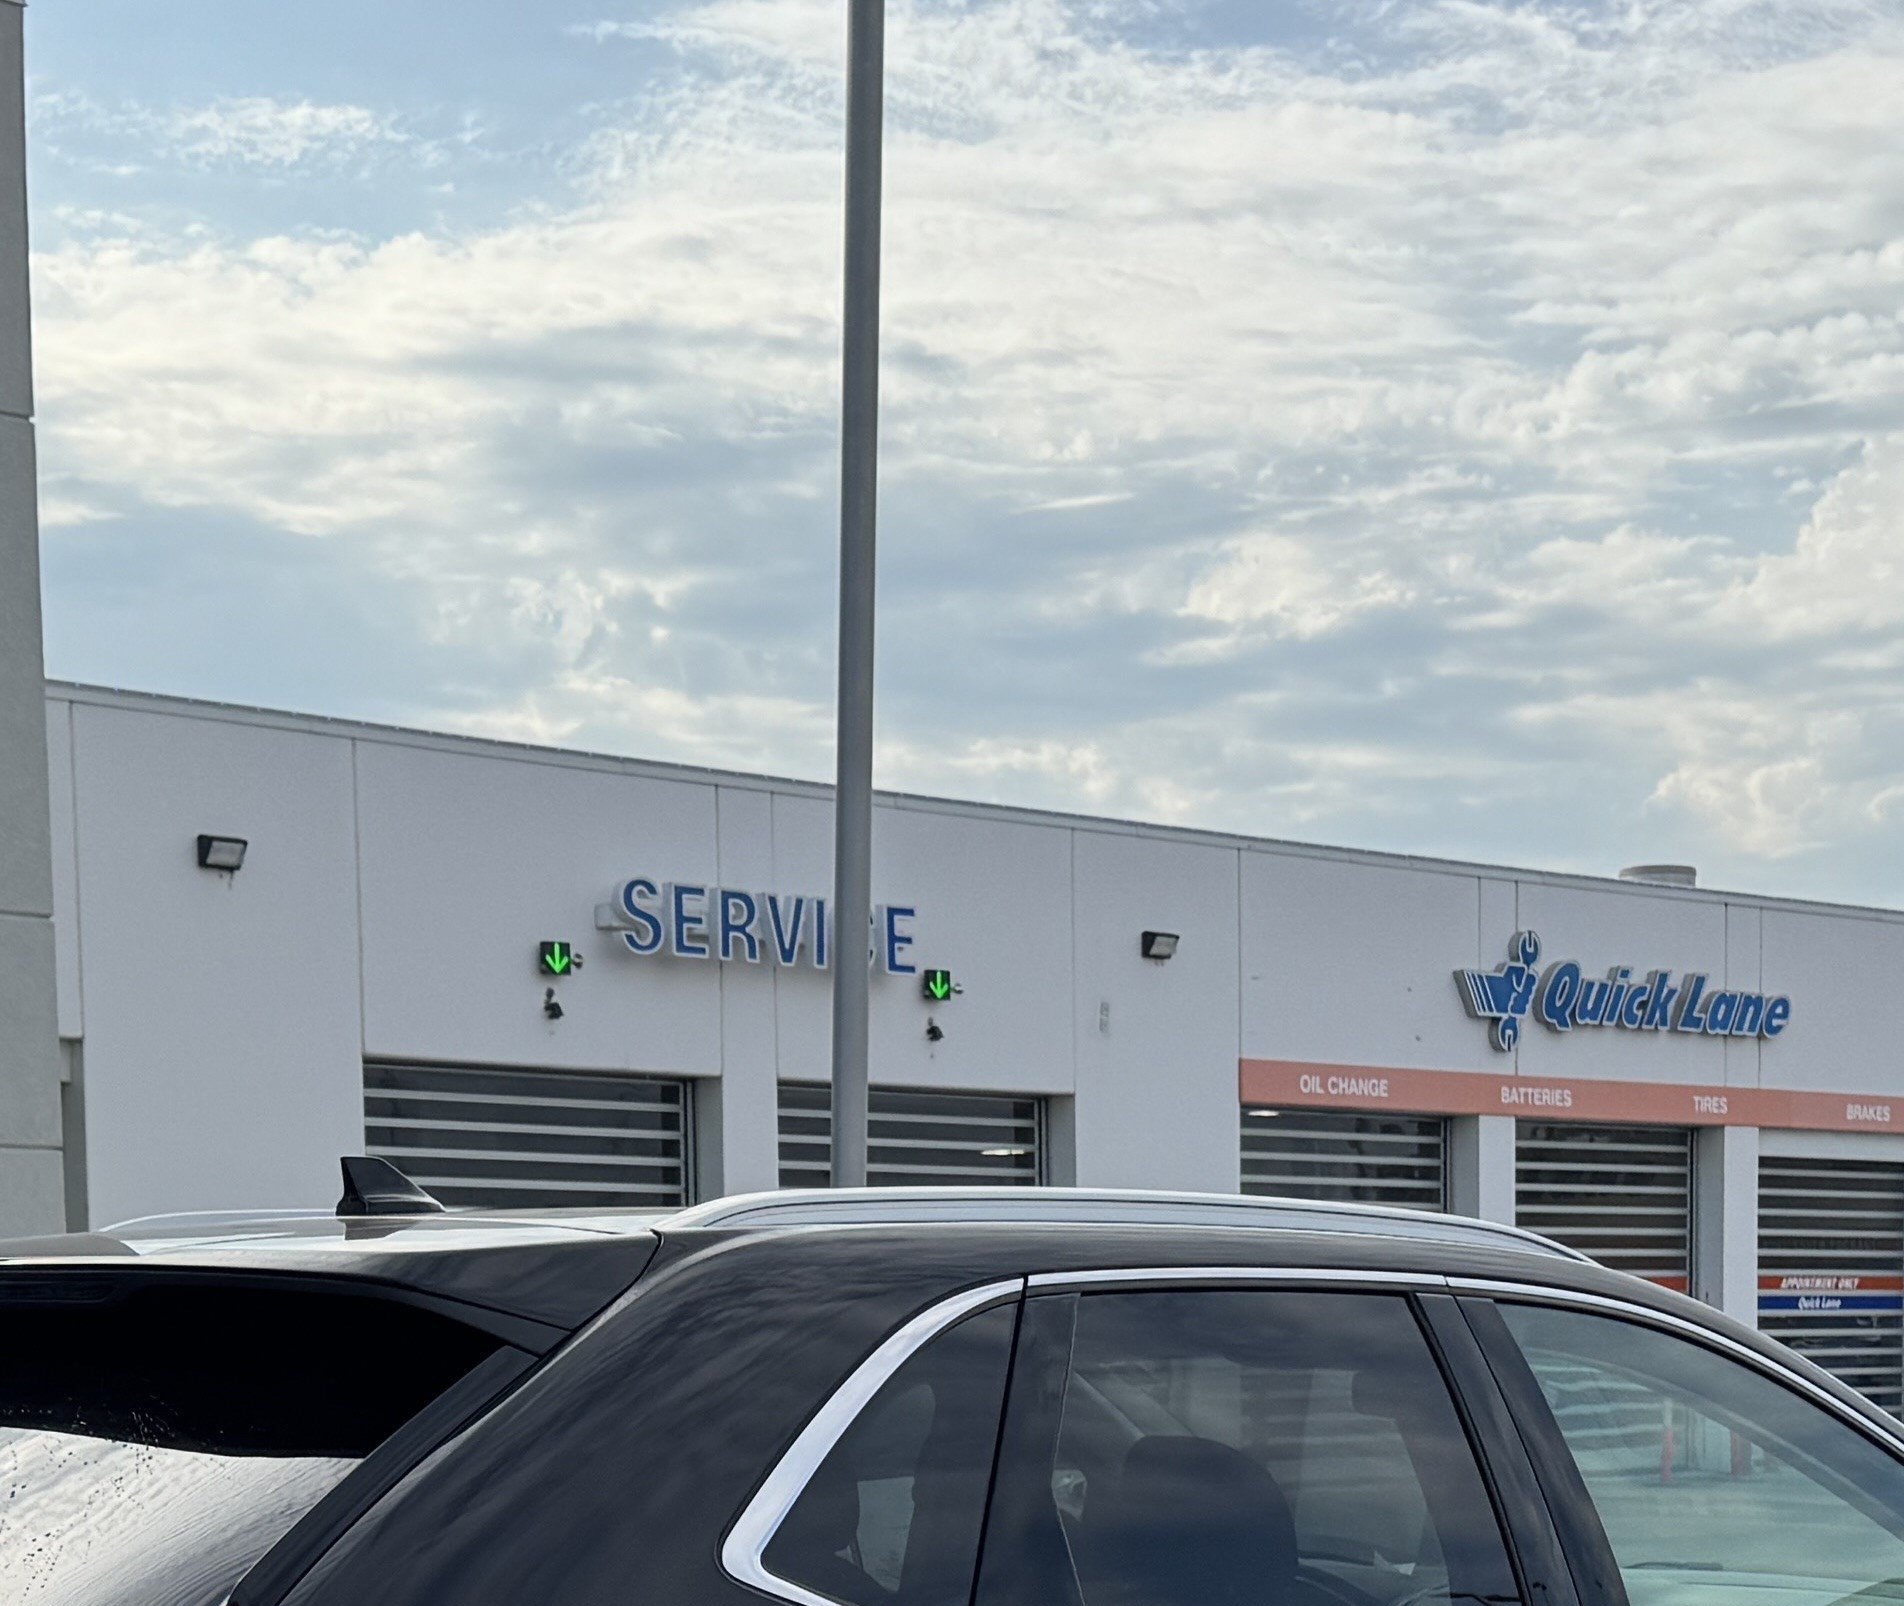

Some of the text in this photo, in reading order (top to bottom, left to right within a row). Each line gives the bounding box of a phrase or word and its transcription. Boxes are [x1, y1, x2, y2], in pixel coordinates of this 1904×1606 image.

[619, 876, 918, 976] SERVIE
[1541, 960, 1793, 1040] Quick Lane
[1299, 1074, 1891, 1122] OIL CHANGE BATTERIES TIRES BRAKES
